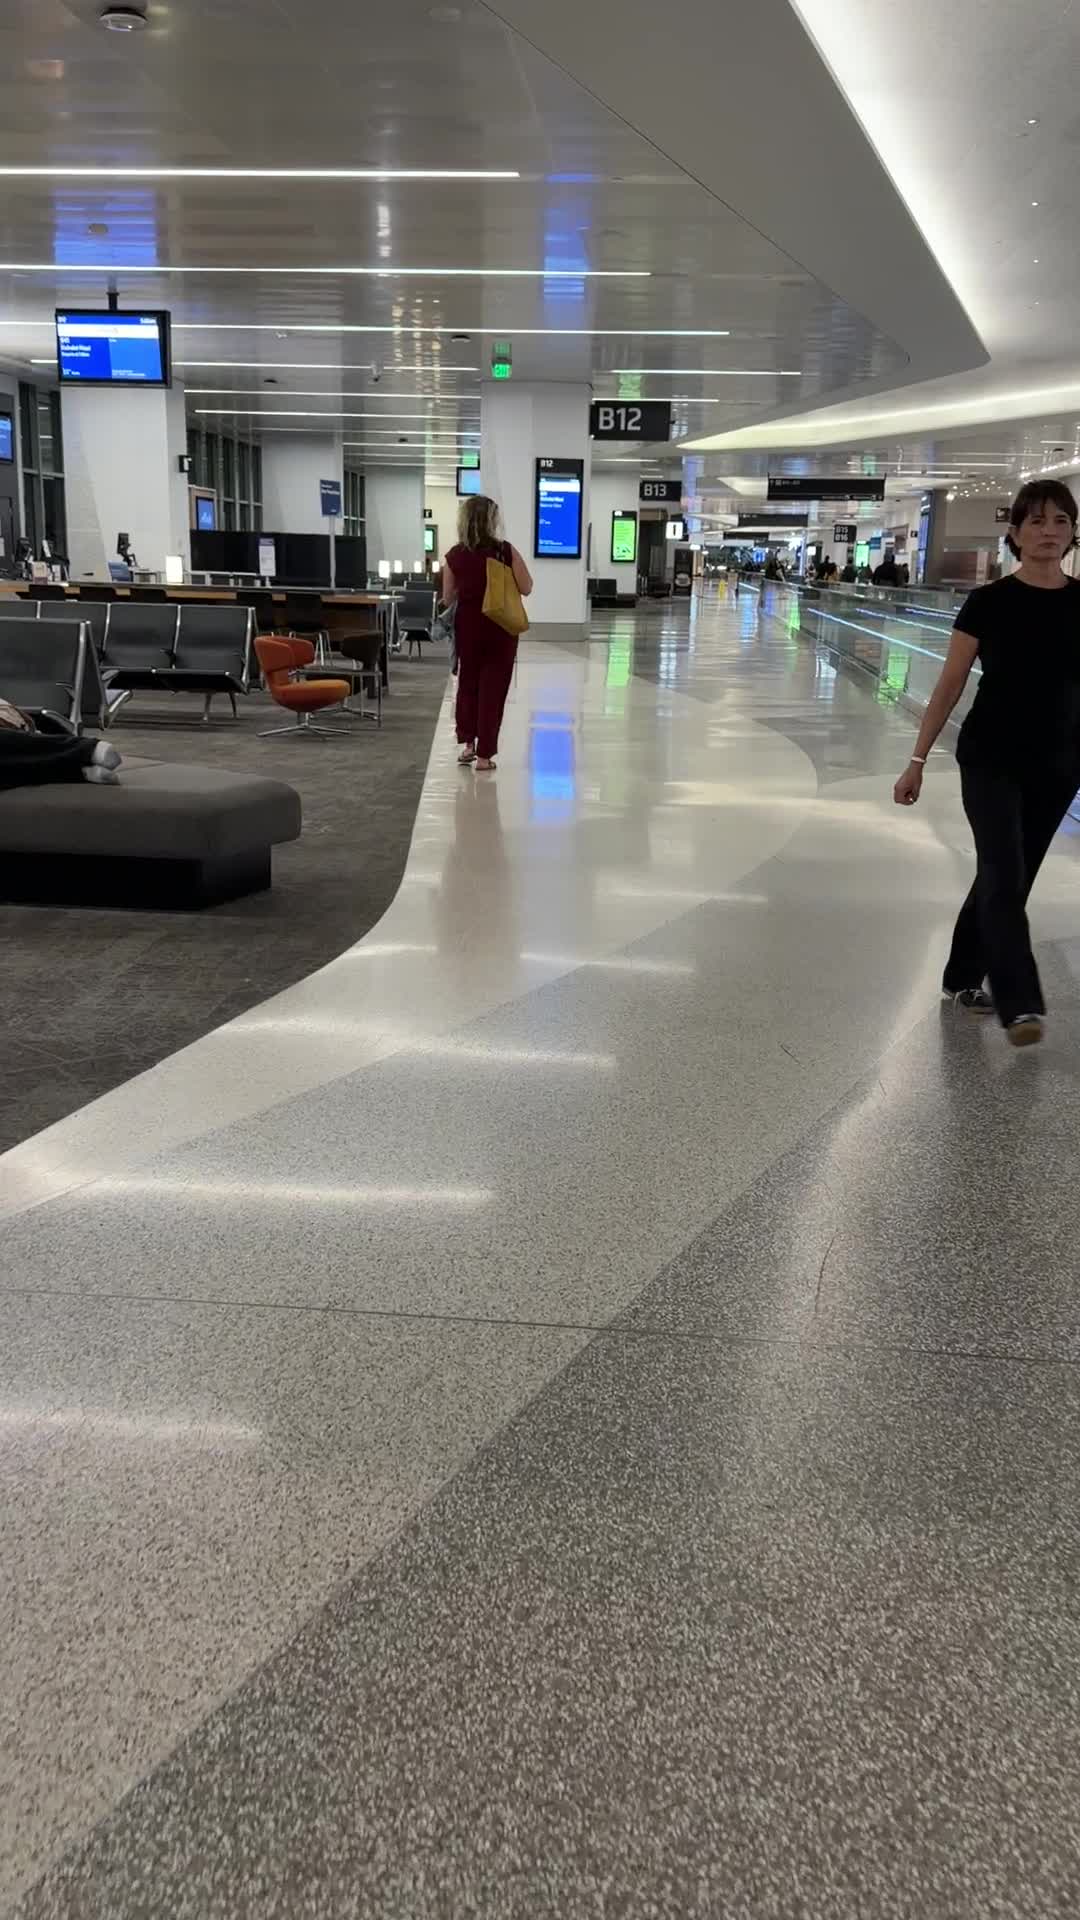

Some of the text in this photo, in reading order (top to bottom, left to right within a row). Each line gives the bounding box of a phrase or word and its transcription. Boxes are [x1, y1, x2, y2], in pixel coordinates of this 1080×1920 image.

[599, 407, 641, 431] B12
[541, 459, 554, 467] B12
[644, 483, 667, 496] B13
